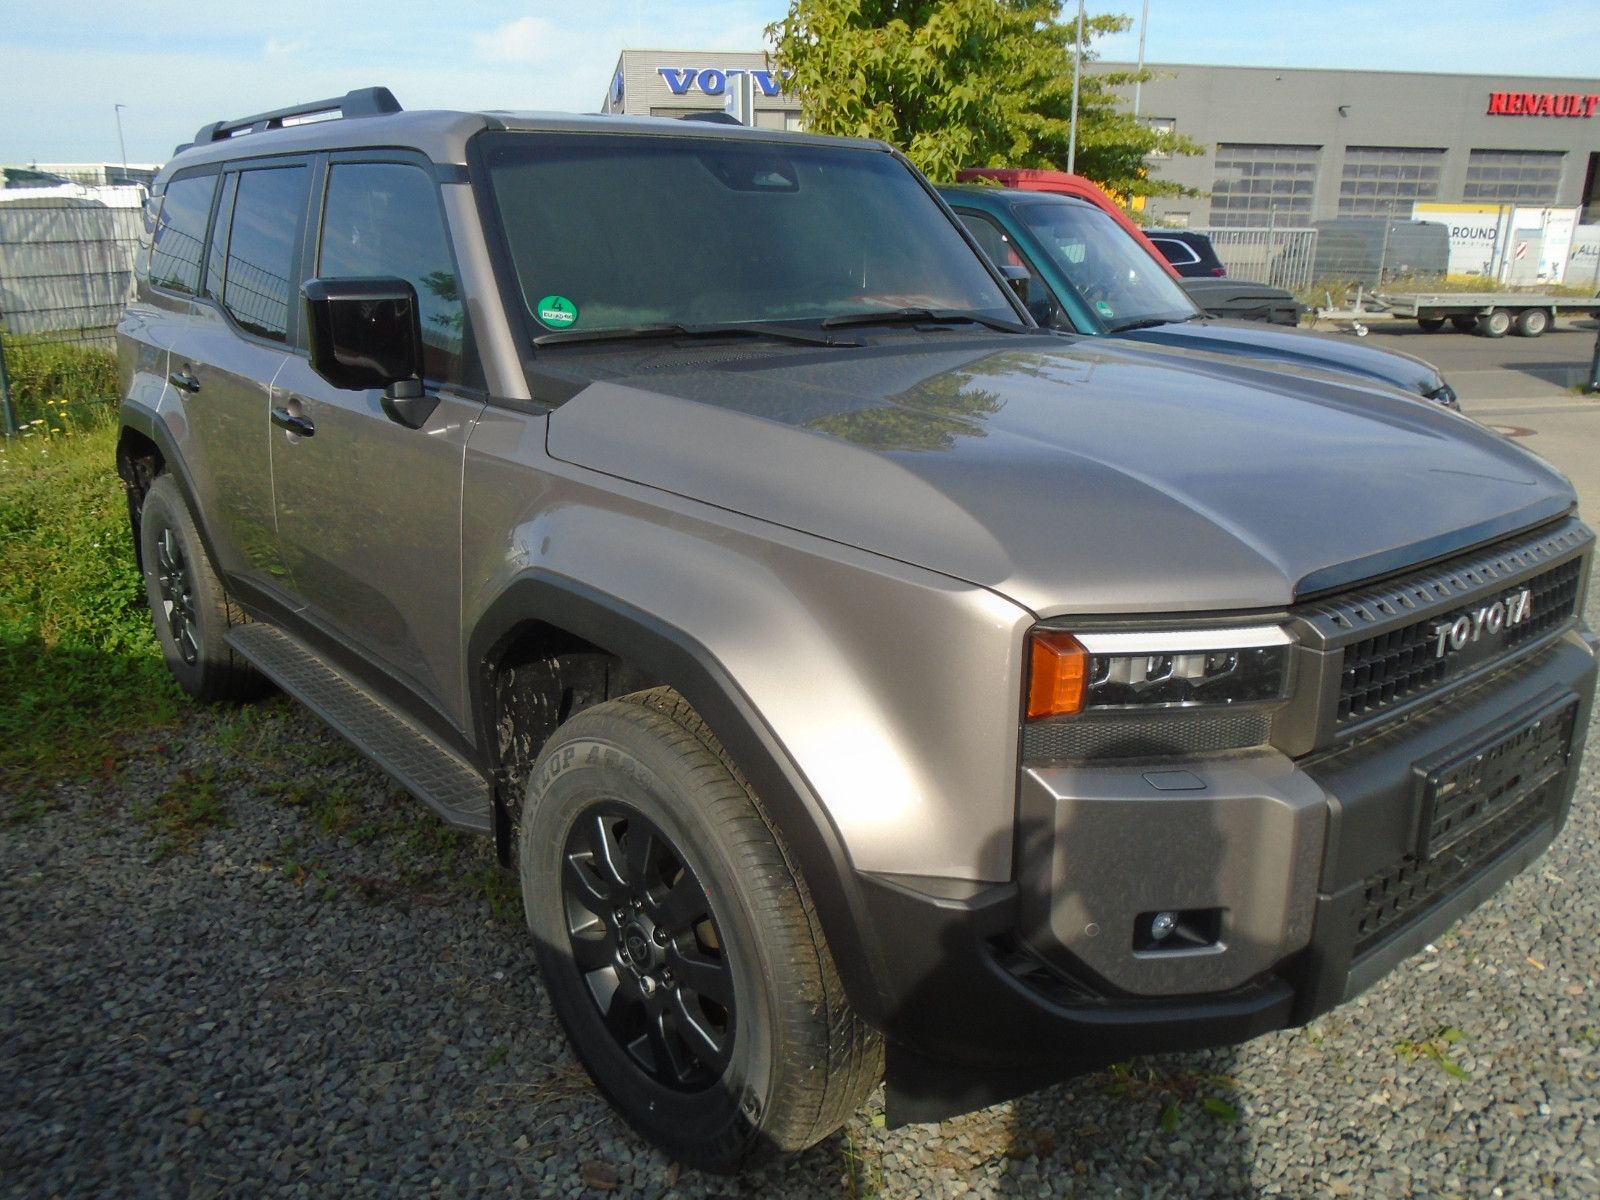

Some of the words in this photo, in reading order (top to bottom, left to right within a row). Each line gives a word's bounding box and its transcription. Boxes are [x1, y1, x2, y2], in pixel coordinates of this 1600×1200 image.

[656, 67, 794, 96] VOV
[1487, 91, 1599, 117] RENAULT
[552, 297, 564, 311] 4
[1434, 589, 1531, 658] TOYOTA
